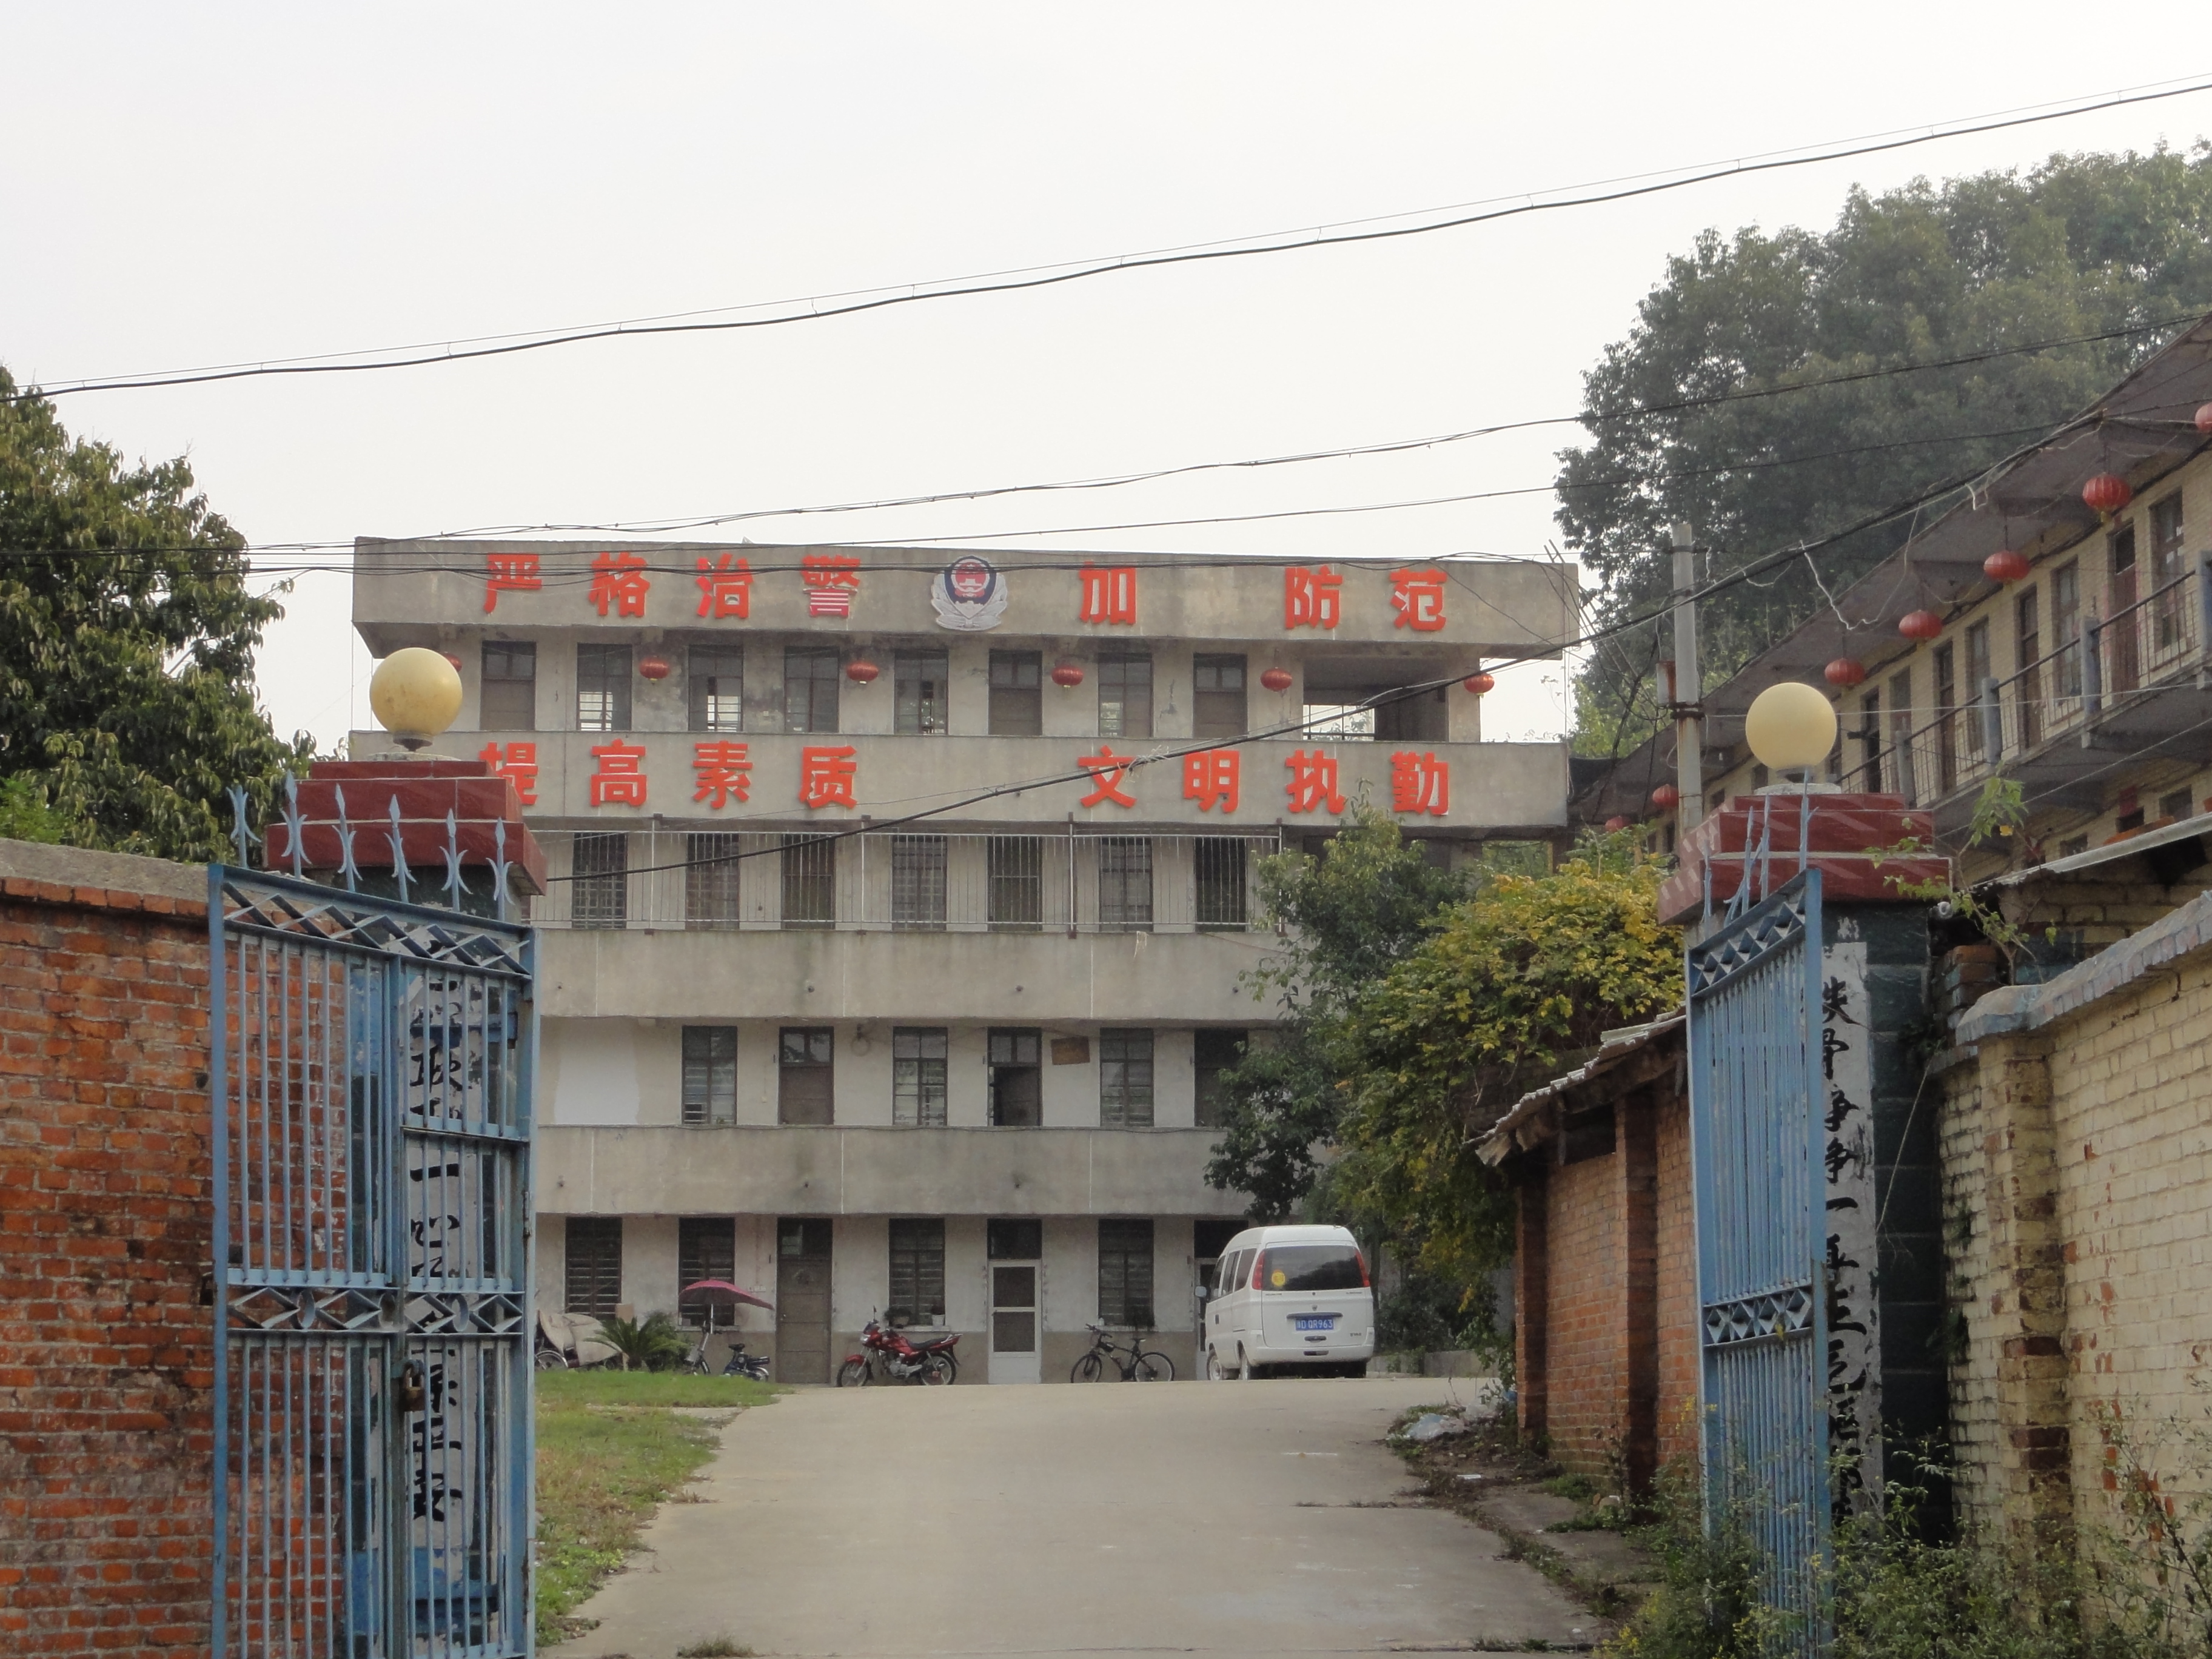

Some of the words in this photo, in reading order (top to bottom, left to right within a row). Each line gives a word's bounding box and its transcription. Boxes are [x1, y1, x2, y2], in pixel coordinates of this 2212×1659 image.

[485, 552, 860, 618] 严格治警
[479, 739, 858, 809] 提高素质
[1078, 745, 1449, 816] 文明执勤
